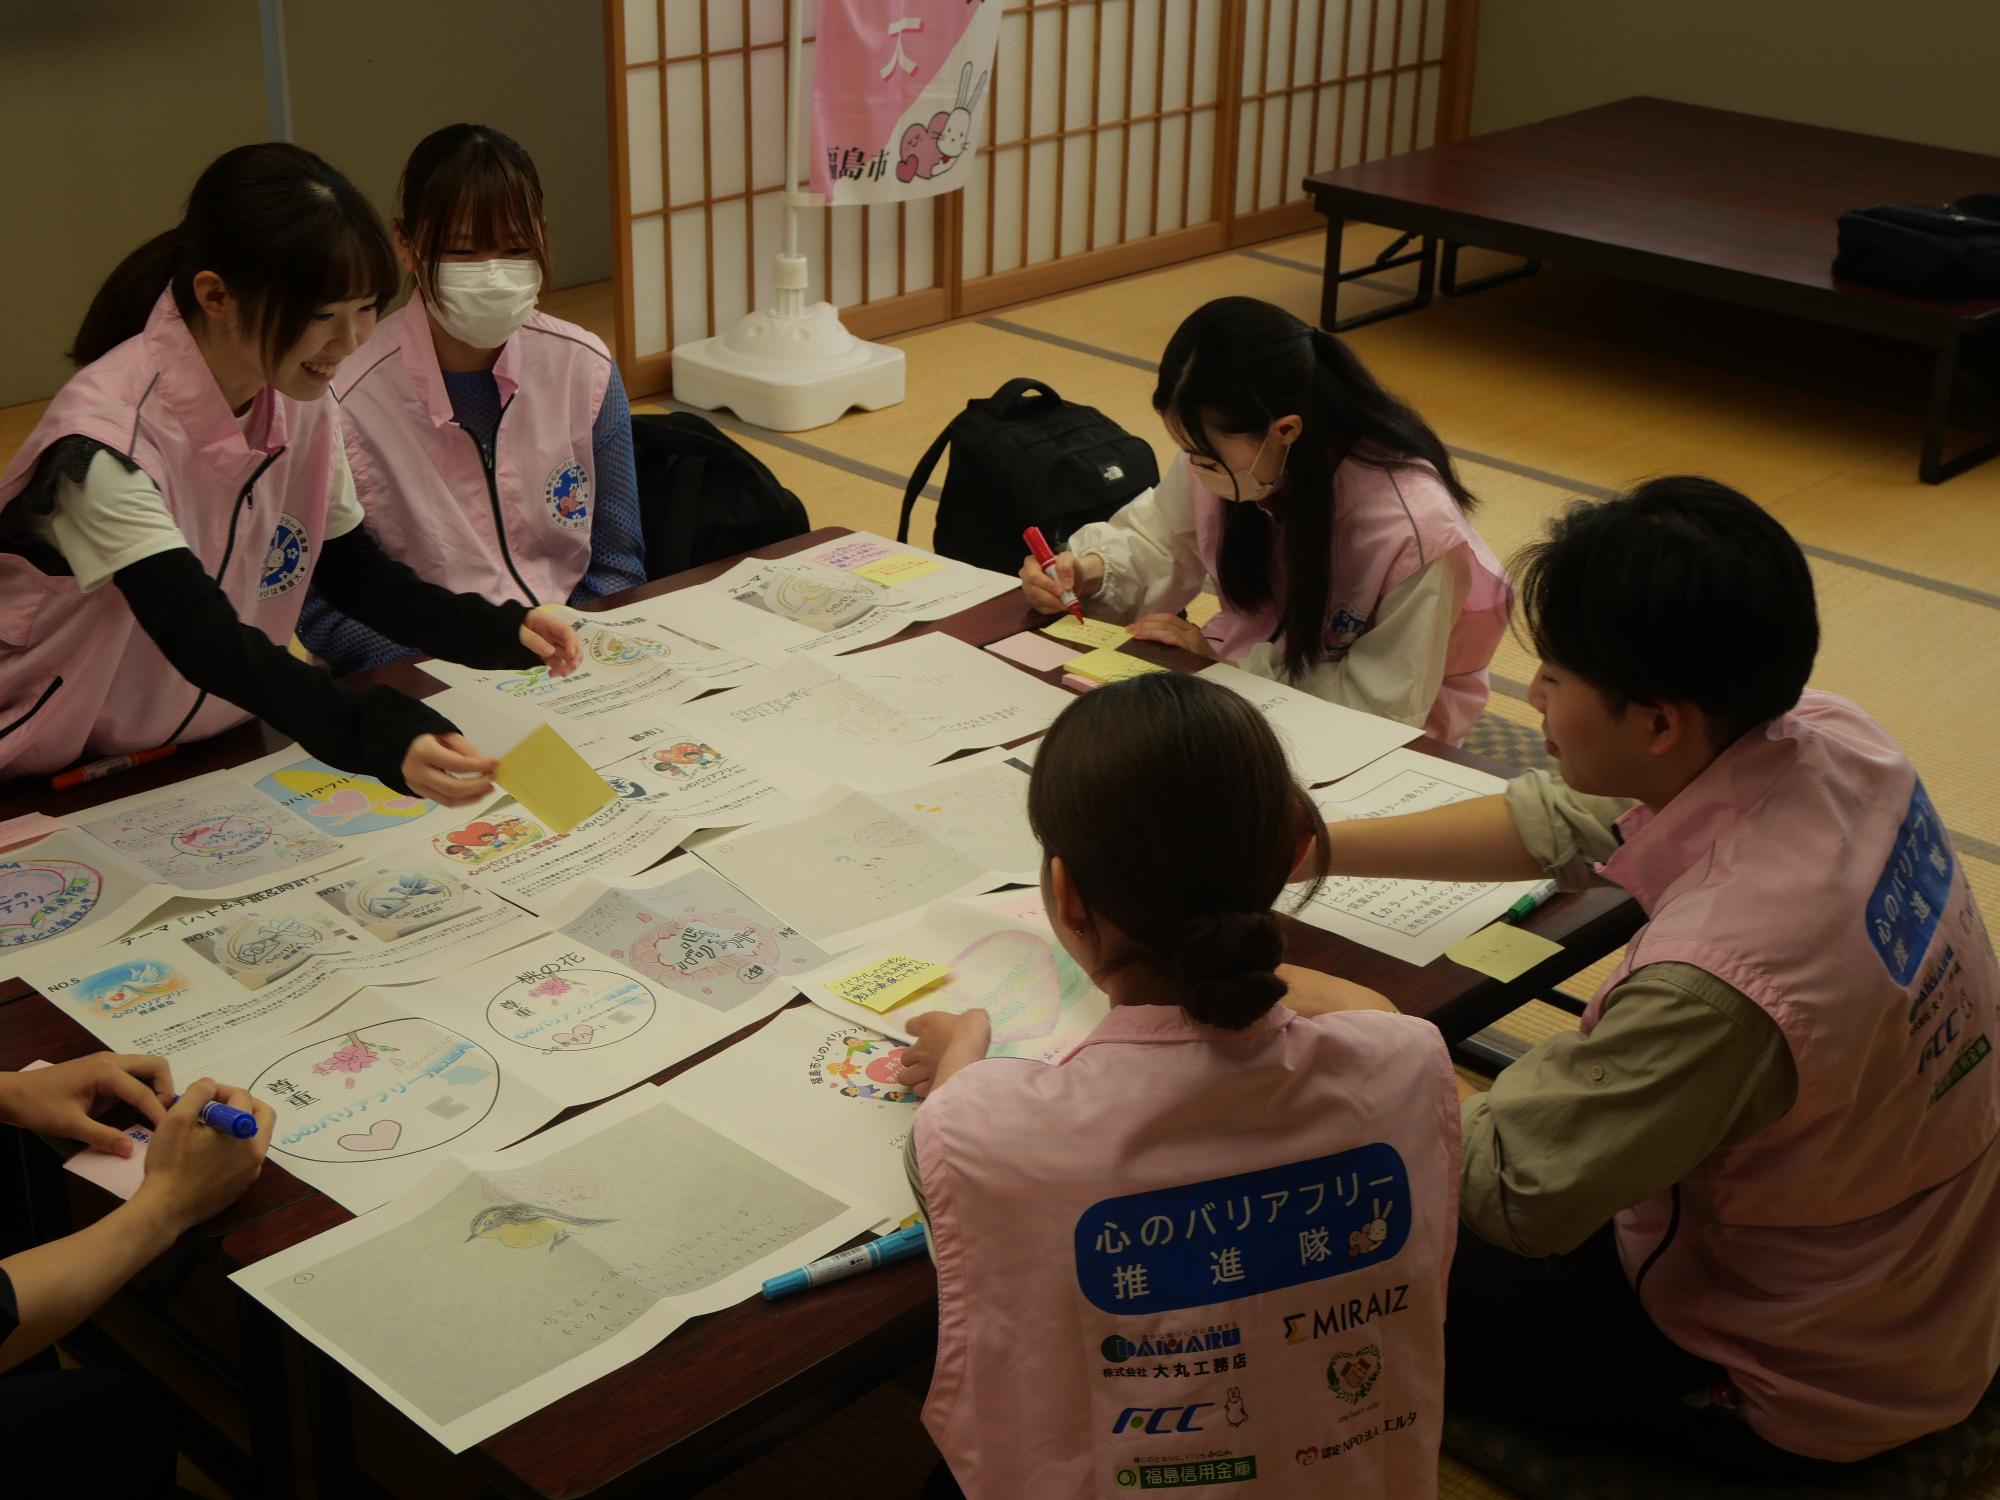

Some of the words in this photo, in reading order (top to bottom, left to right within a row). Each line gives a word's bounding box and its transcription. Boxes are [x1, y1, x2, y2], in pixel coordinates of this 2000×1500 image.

[119, 924, 170, 946] テーマ
[514, 951, 587, 985] 桃の花
[47, 977, 82, 994] NO.5
[265, 1077, 322, 1111] 尊重
[1095, 1172, 1394, 1255] 心のバリアフリー
[1112, 1225, 1333, 1301] 推進隊
[1313, 1284, 1410, 1340] MIRAIZ
[1115, 1328, 1241, 1358] DAIMARU
[1103, 1367, 1148, 1379] 株式会社
[1153, 1351, 1248, 1380] 大丸工務店
[1112, 1402, 1216, 1435] FCC
[1383, 1411, 1417, 1432] エルタ
[1145, 1461, 1251, 1486] 福島信用金庫
